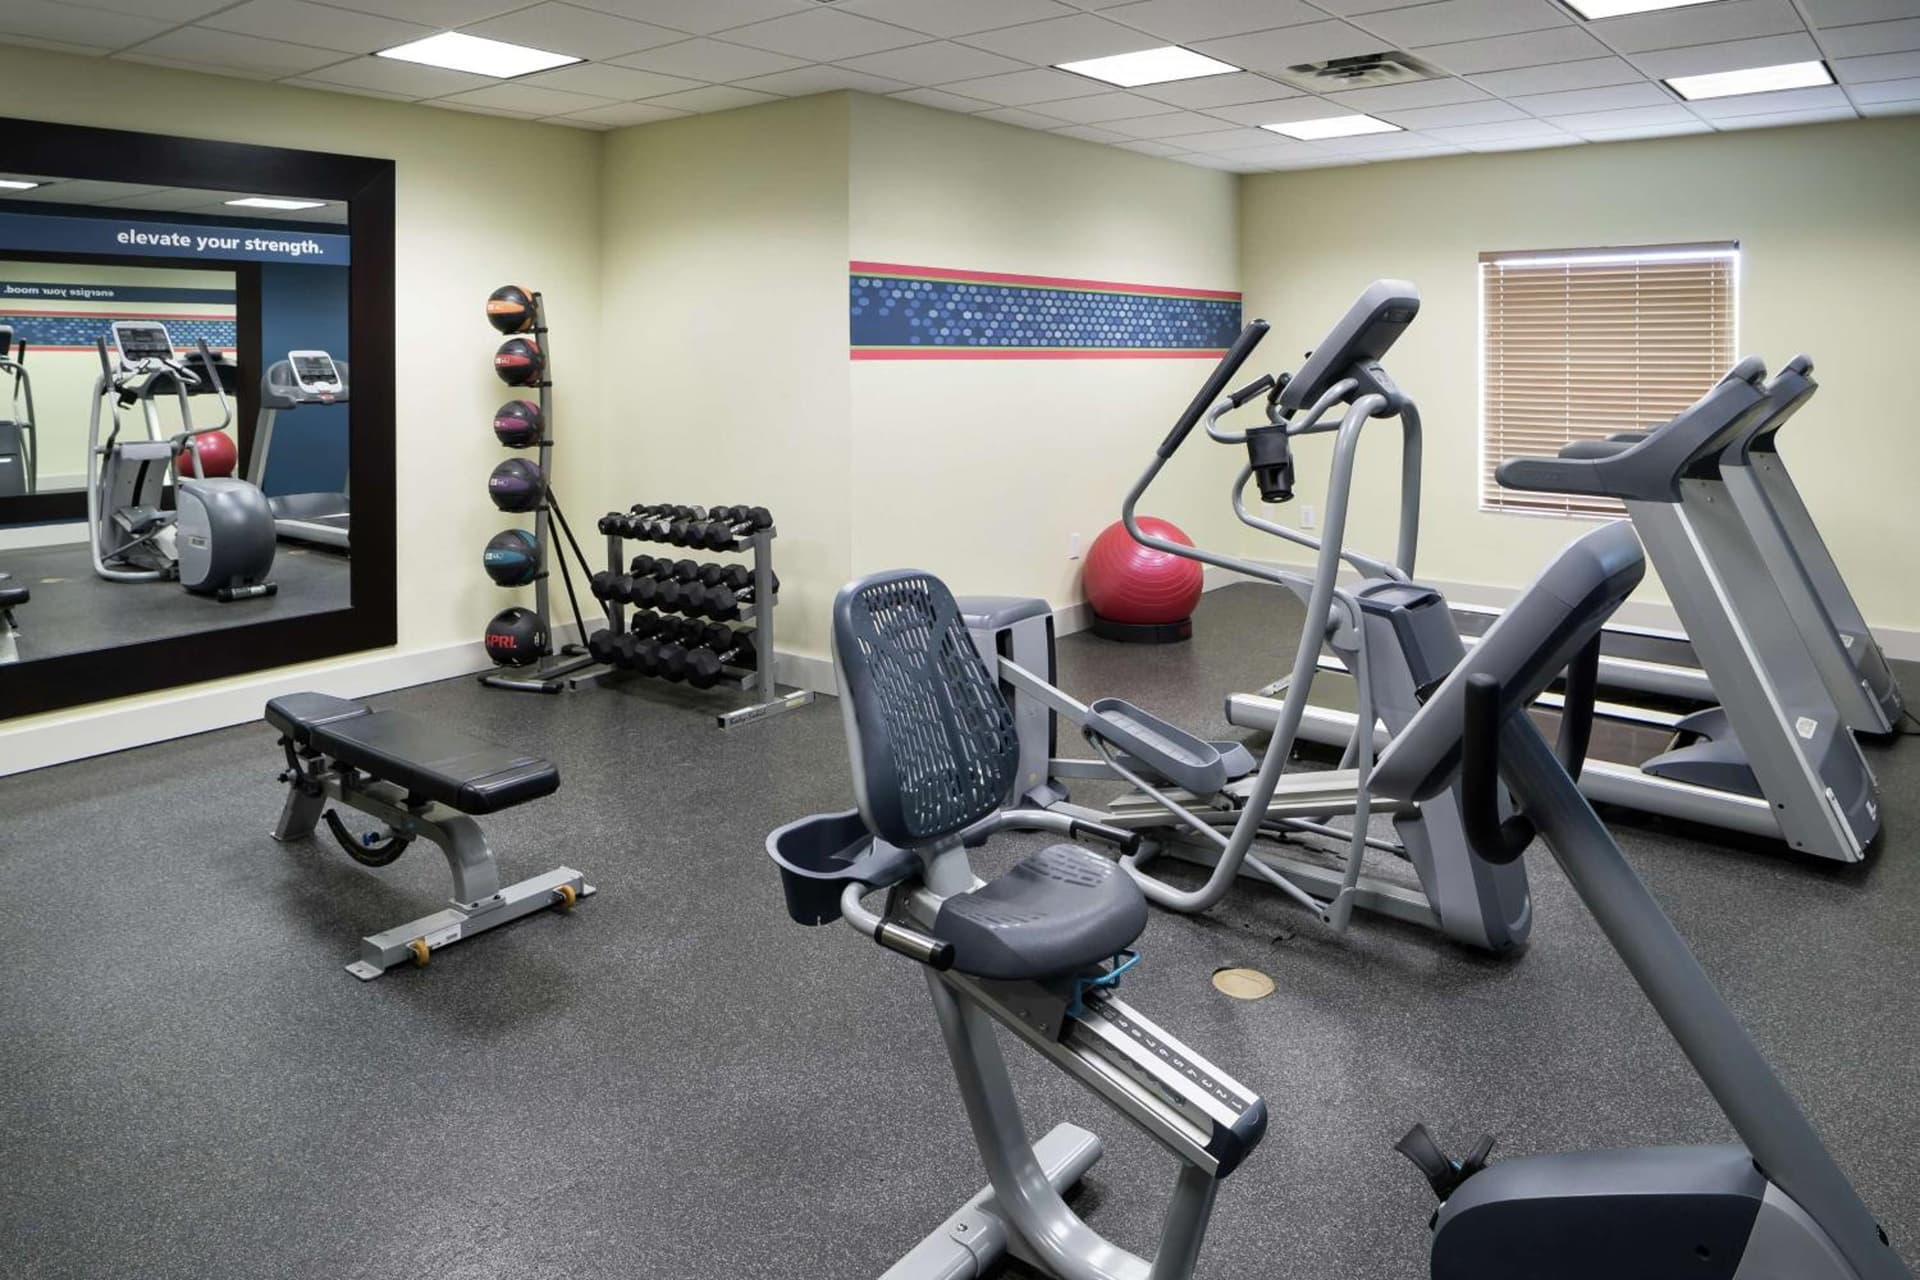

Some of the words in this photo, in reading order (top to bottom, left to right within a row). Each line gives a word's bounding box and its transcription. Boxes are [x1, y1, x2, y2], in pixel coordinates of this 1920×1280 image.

[117, 229, 191, 247] elevate
[197, 235, 240, 251] your
[244, 237, 324, 257] strength.
[1145, 1037, 1156, 1047] 7
[1173, 1058, 1185, 1068] 5
[1187, 1068, 1198, 1078] 4
[1201, 1079, 1213, 1088] 3
[1216, 1089, 1228, 1099] 2
[1232, 1101, 1243, 1110] 1
